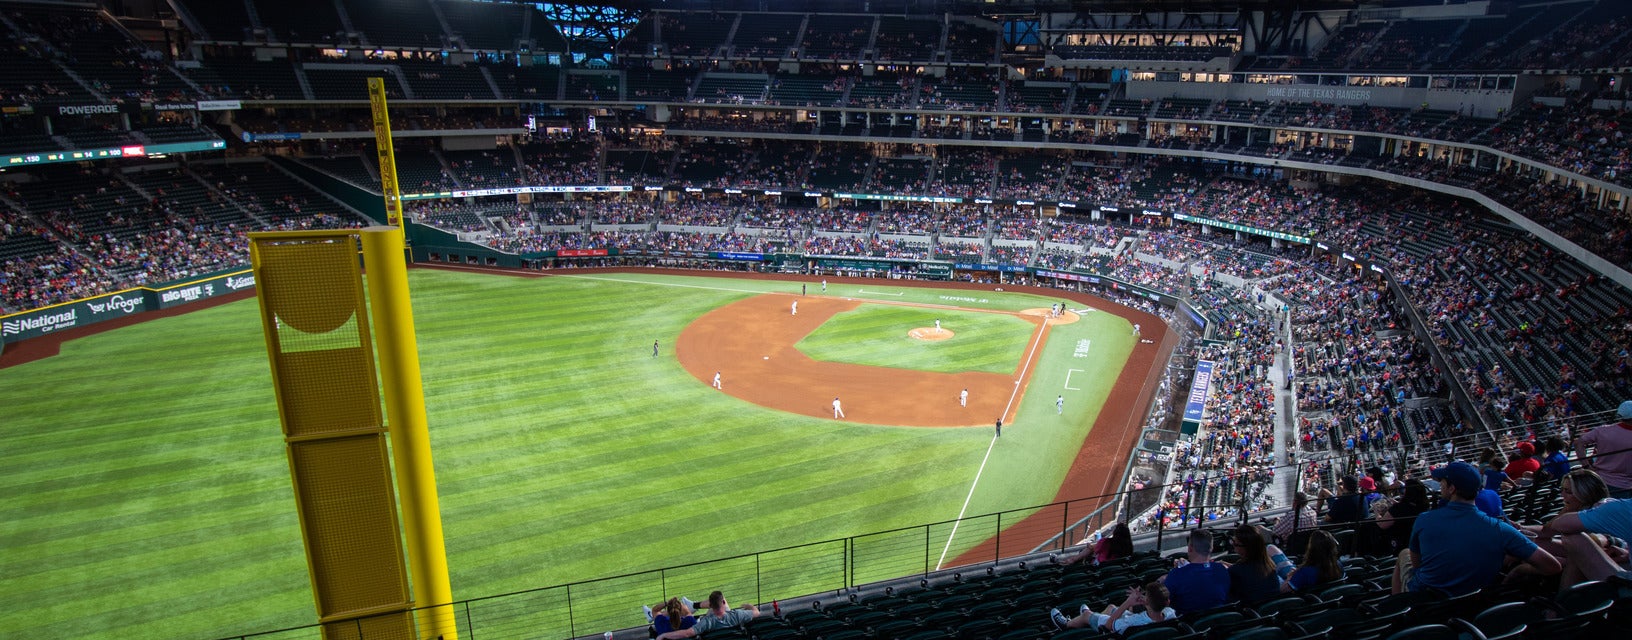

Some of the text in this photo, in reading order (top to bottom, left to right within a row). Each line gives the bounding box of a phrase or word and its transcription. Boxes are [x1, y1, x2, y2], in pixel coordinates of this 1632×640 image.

[1267, 88, 1371, 100] HOME OF THE TEXAS RANGERS
[59, 104, 119, 116] POWERADE
[162, 286, 202, 303] BIG BITE
[106, 294, 144, 313] Kroger
[20, 308, 76, 332] National
[41, 320, 76, 333] Car Rental
[1194, 371, 1210, 390] RANGERS
[1190, 389, 1206, 404] TEXAS
